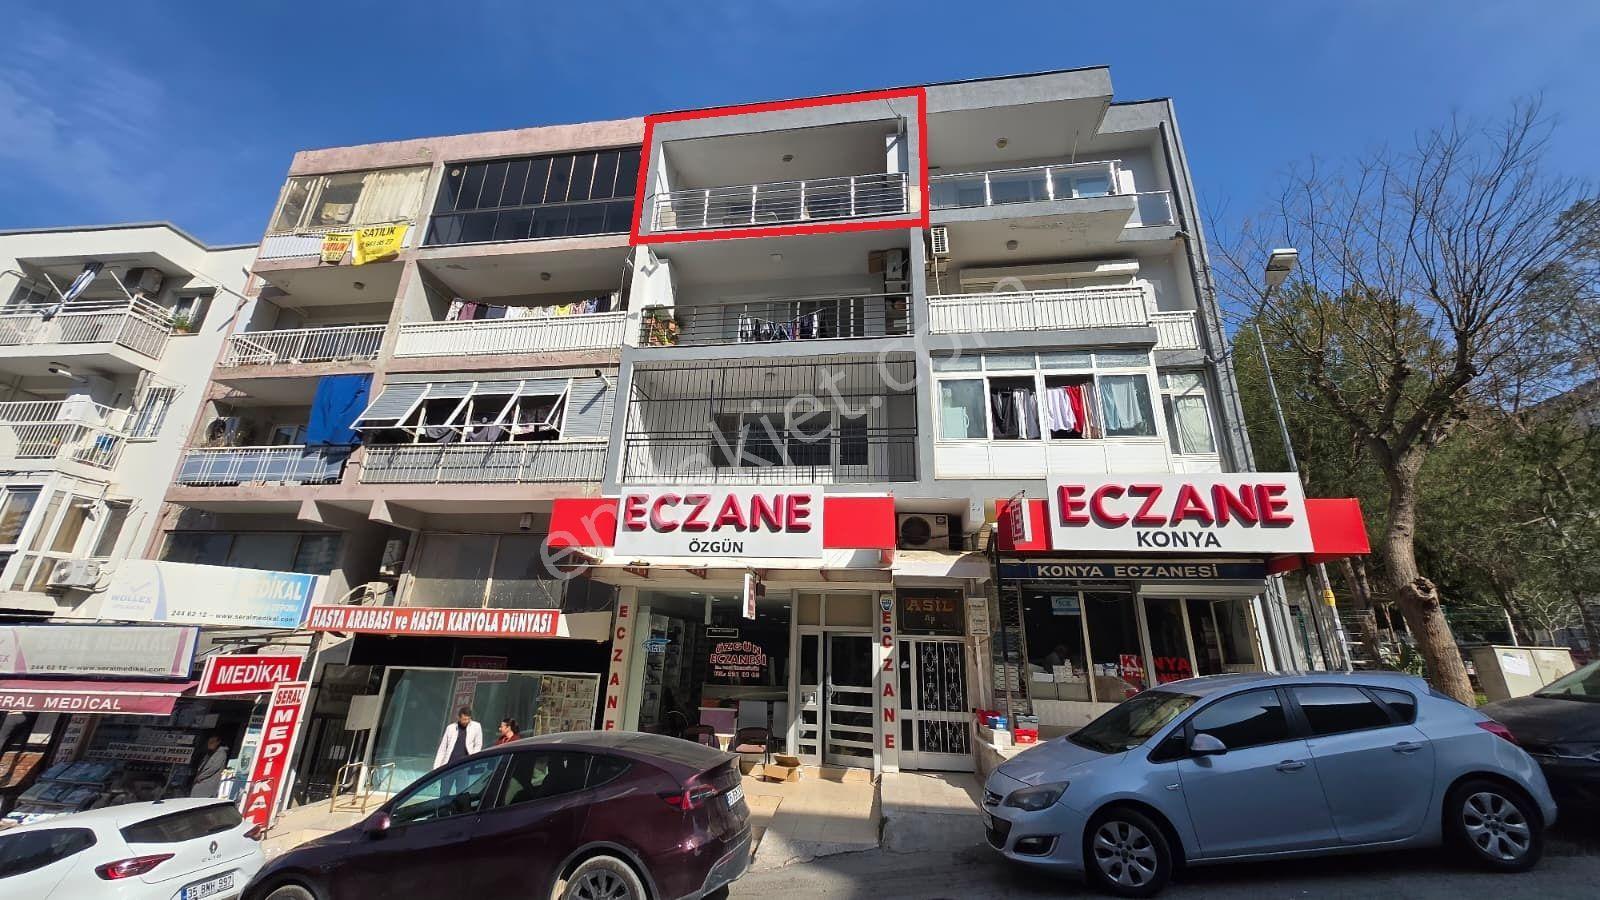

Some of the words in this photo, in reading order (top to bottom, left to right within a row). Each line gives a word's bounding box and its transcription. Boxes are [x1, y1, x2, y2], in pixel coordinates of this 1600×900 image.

[621, 493, 812, 533] ECZANE
[1057, 484, 1295, 529] ECZANE
[688, 537, 744, 554] ÖZGÜN
[1136, 531, 1222, 549] KONYA
[1037, 565, 1104, 578] KONYA
[1114, 564, 1218, 578] ECZANESİ
[312, 609, 346, 629] HASTA
[346, 610, 394, 630] ARABASI
[394, 616, 407, 630] ve
[410, 611, 444, 631] HASTA
[447, 613, 498, 632] KARYOLA
[502, 612, 552, 633] DÜNYASI
[216, 660, 291, 686] MEDİKAL
[882, 611, 895, 749] ECZANE
[43, 695, 122, 710] MEDİCAL
[276, 686, 303, 705] SERAL
[188, 887, 198, 898] 35
[219, 875, 232, 889] 997
